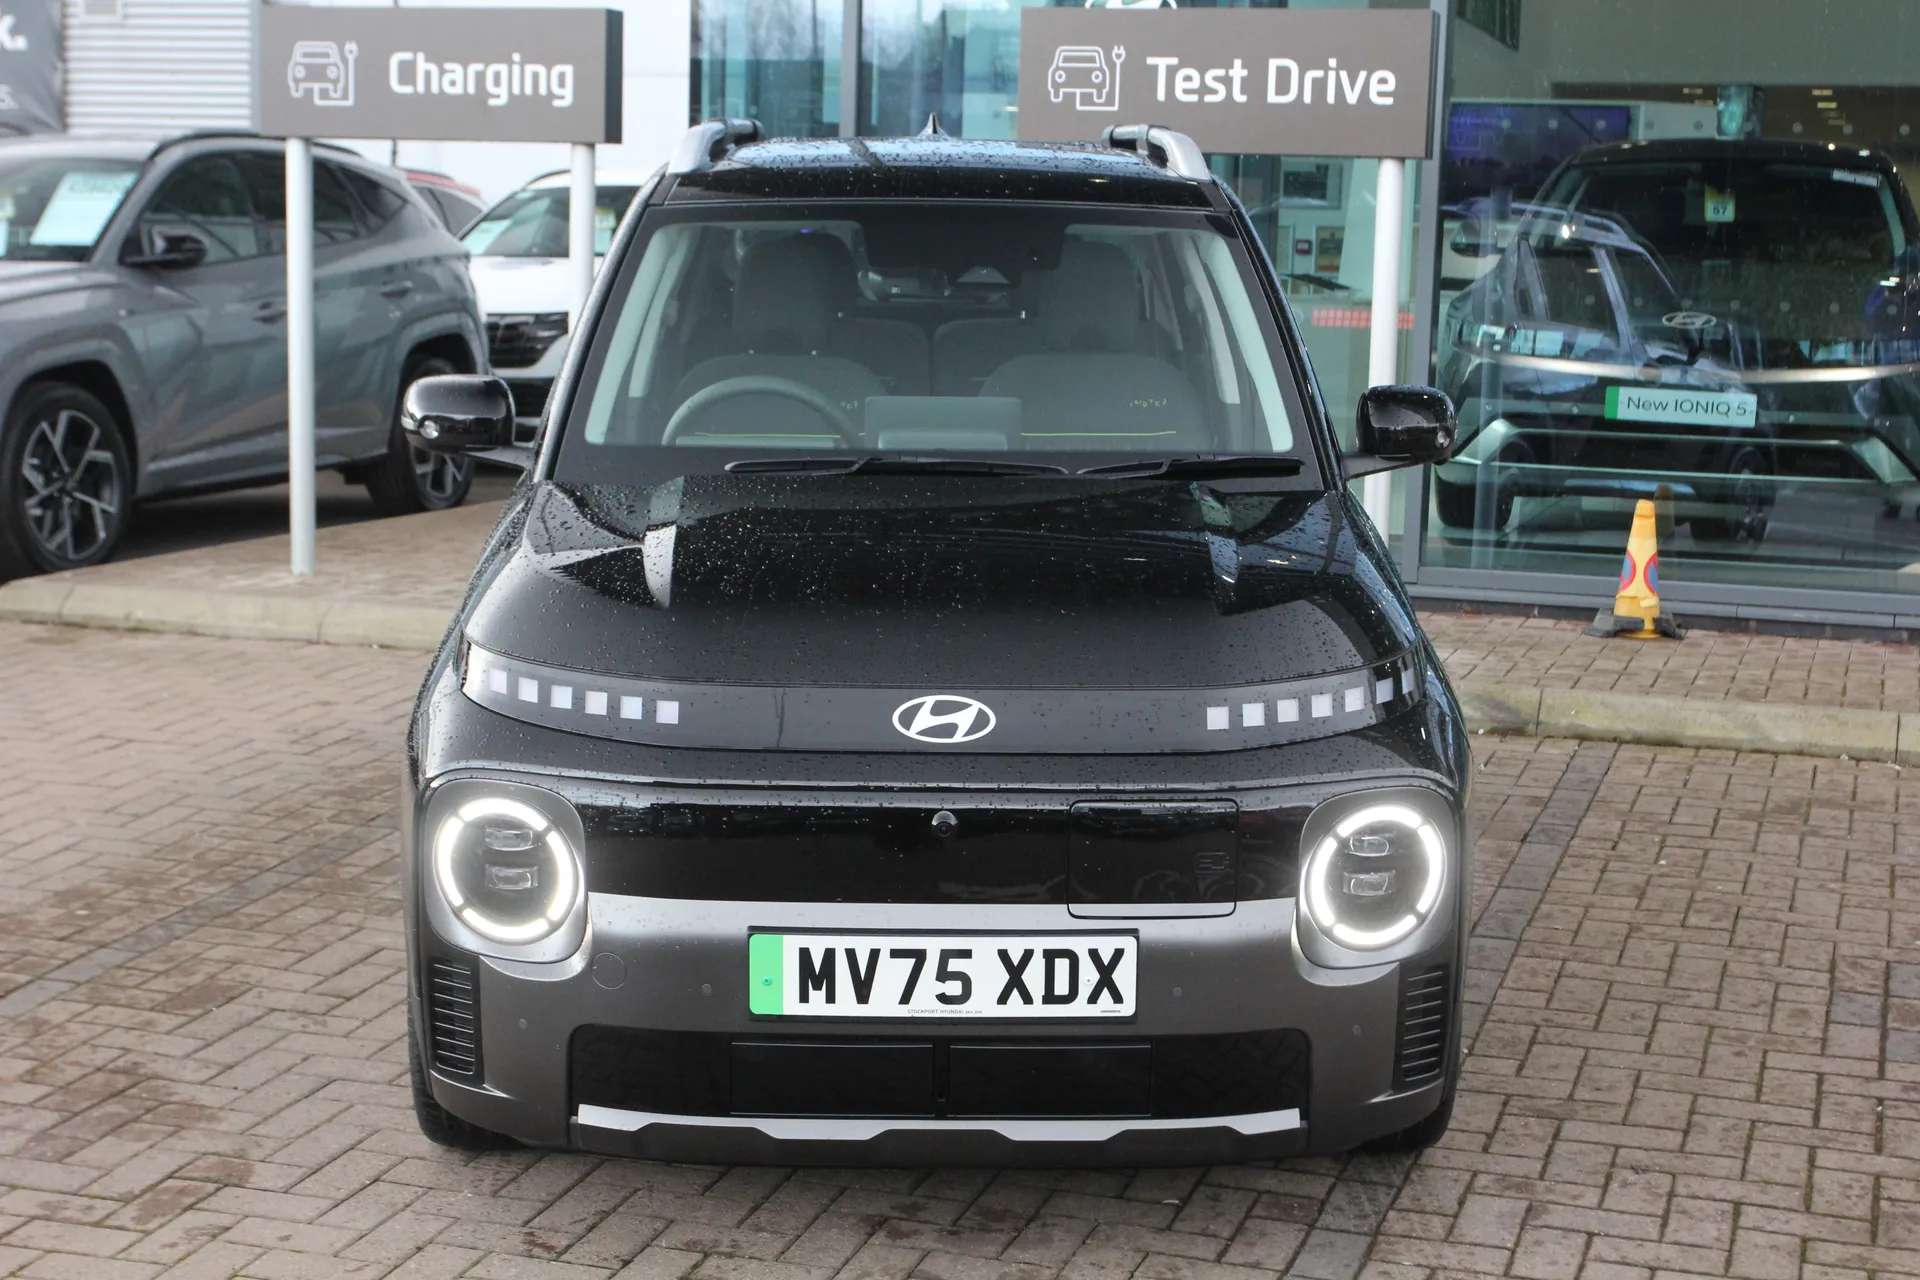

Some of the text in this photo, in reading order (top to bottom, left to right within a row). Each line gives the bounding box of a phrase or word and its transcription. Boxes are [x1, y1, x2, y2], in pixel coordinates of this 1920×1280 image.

[388, 50, 575, 108] Charging
[1145, 56, 1397, 106] Test Drive
[1627, 396, 1748, 418] New IONIQ 5
[798, 947, 1125, 1006] MV75 XDX
